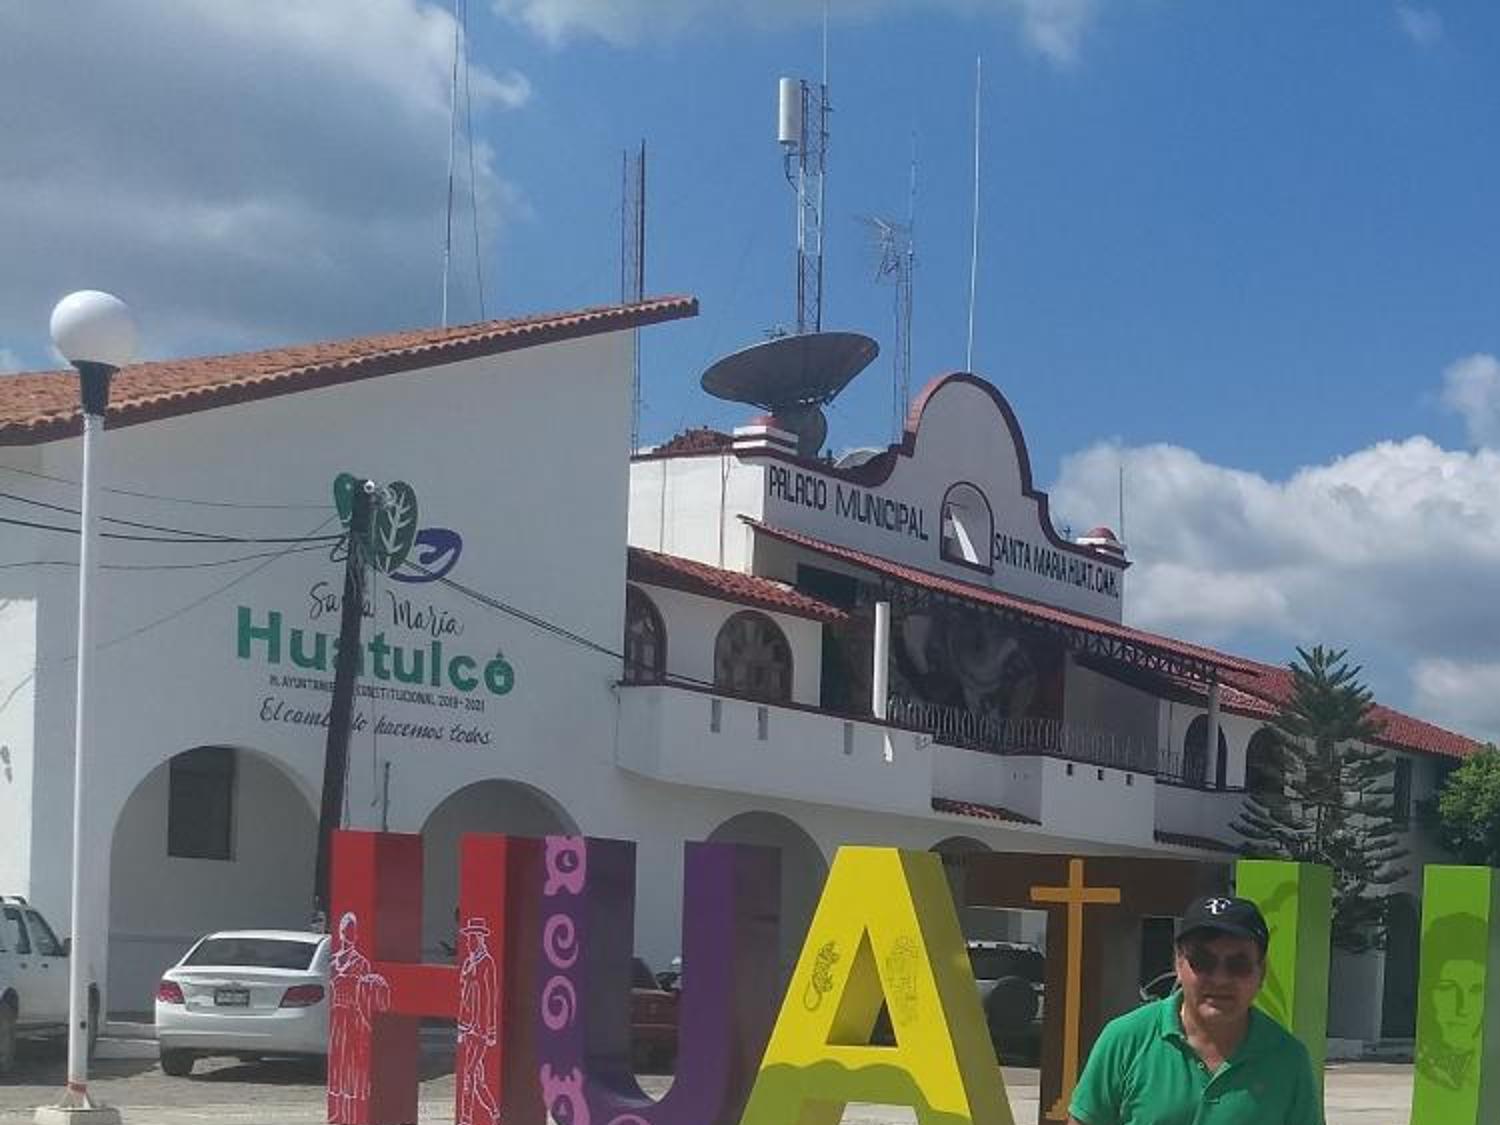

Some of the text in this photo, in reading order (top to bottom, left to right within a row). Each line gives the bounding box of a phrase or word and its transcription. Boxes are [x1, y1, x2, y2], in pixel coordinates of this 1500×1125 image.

[769, 465, 929, 541] PALACIO MUNICIPAL
[991, 532, 1032, 571] SANTA
